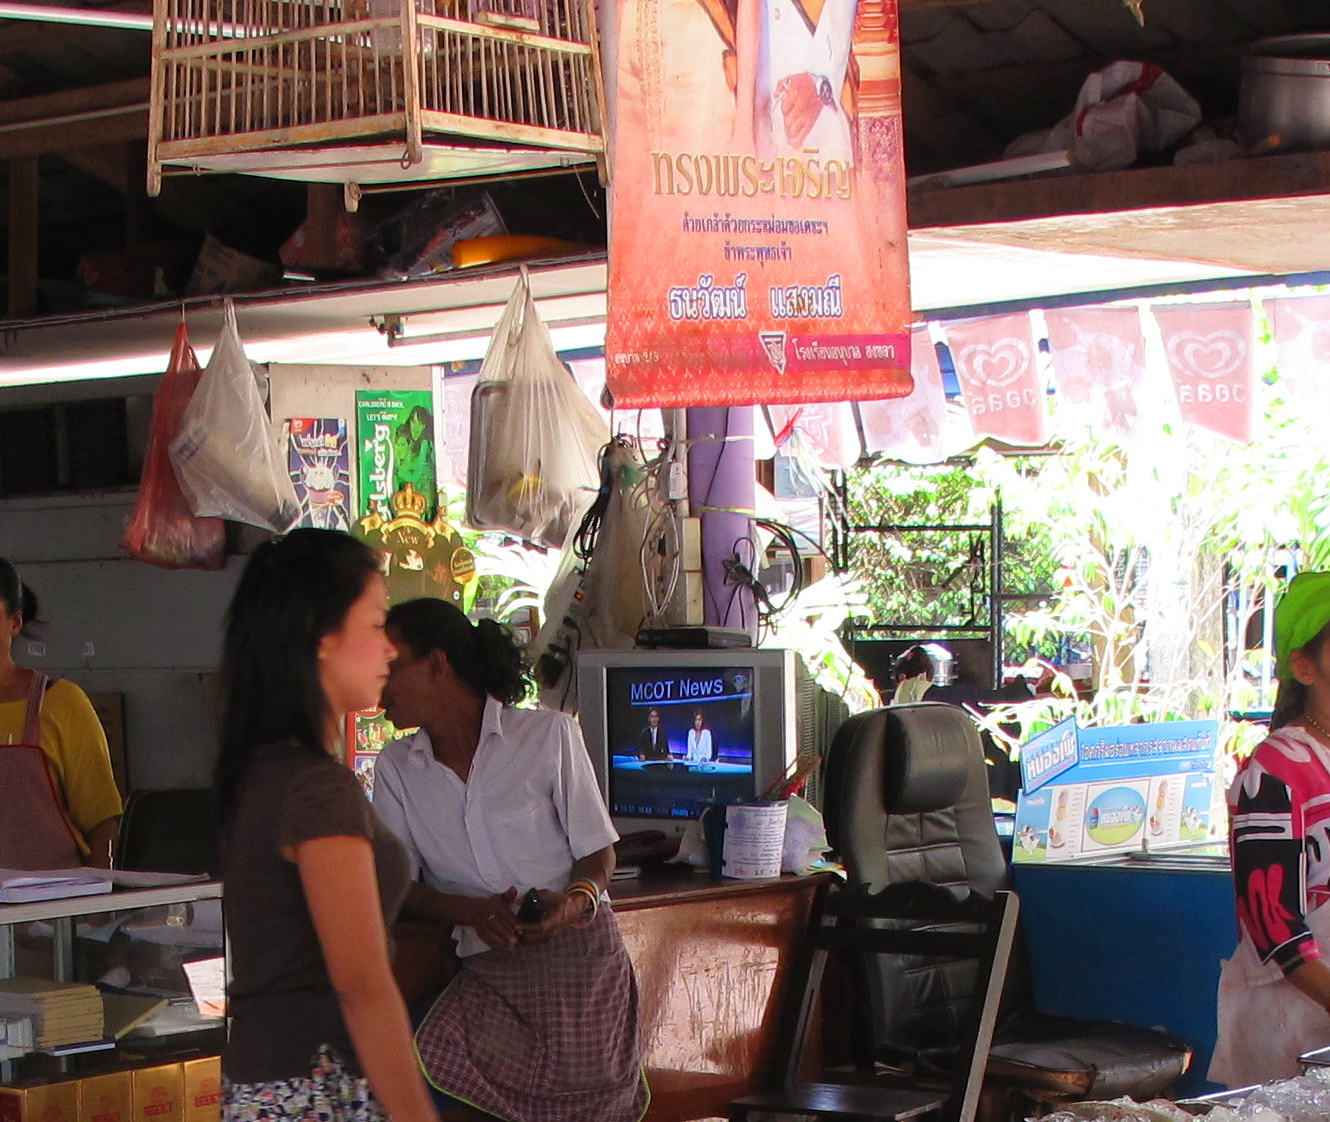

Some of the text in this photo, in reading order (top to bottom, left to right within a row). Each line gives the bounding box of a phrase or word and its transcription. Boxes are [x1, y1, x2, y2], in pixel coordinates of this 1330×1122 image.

[651, 147, 853, 200] ทรงพระเจริญ
[723, 240, 793, 268] ข้าพระพุทธเจ้า
[668, 272, 843, 321] ธนวัฒน์ แสงมณี
[631, 678, 724, 700] MCOT News
